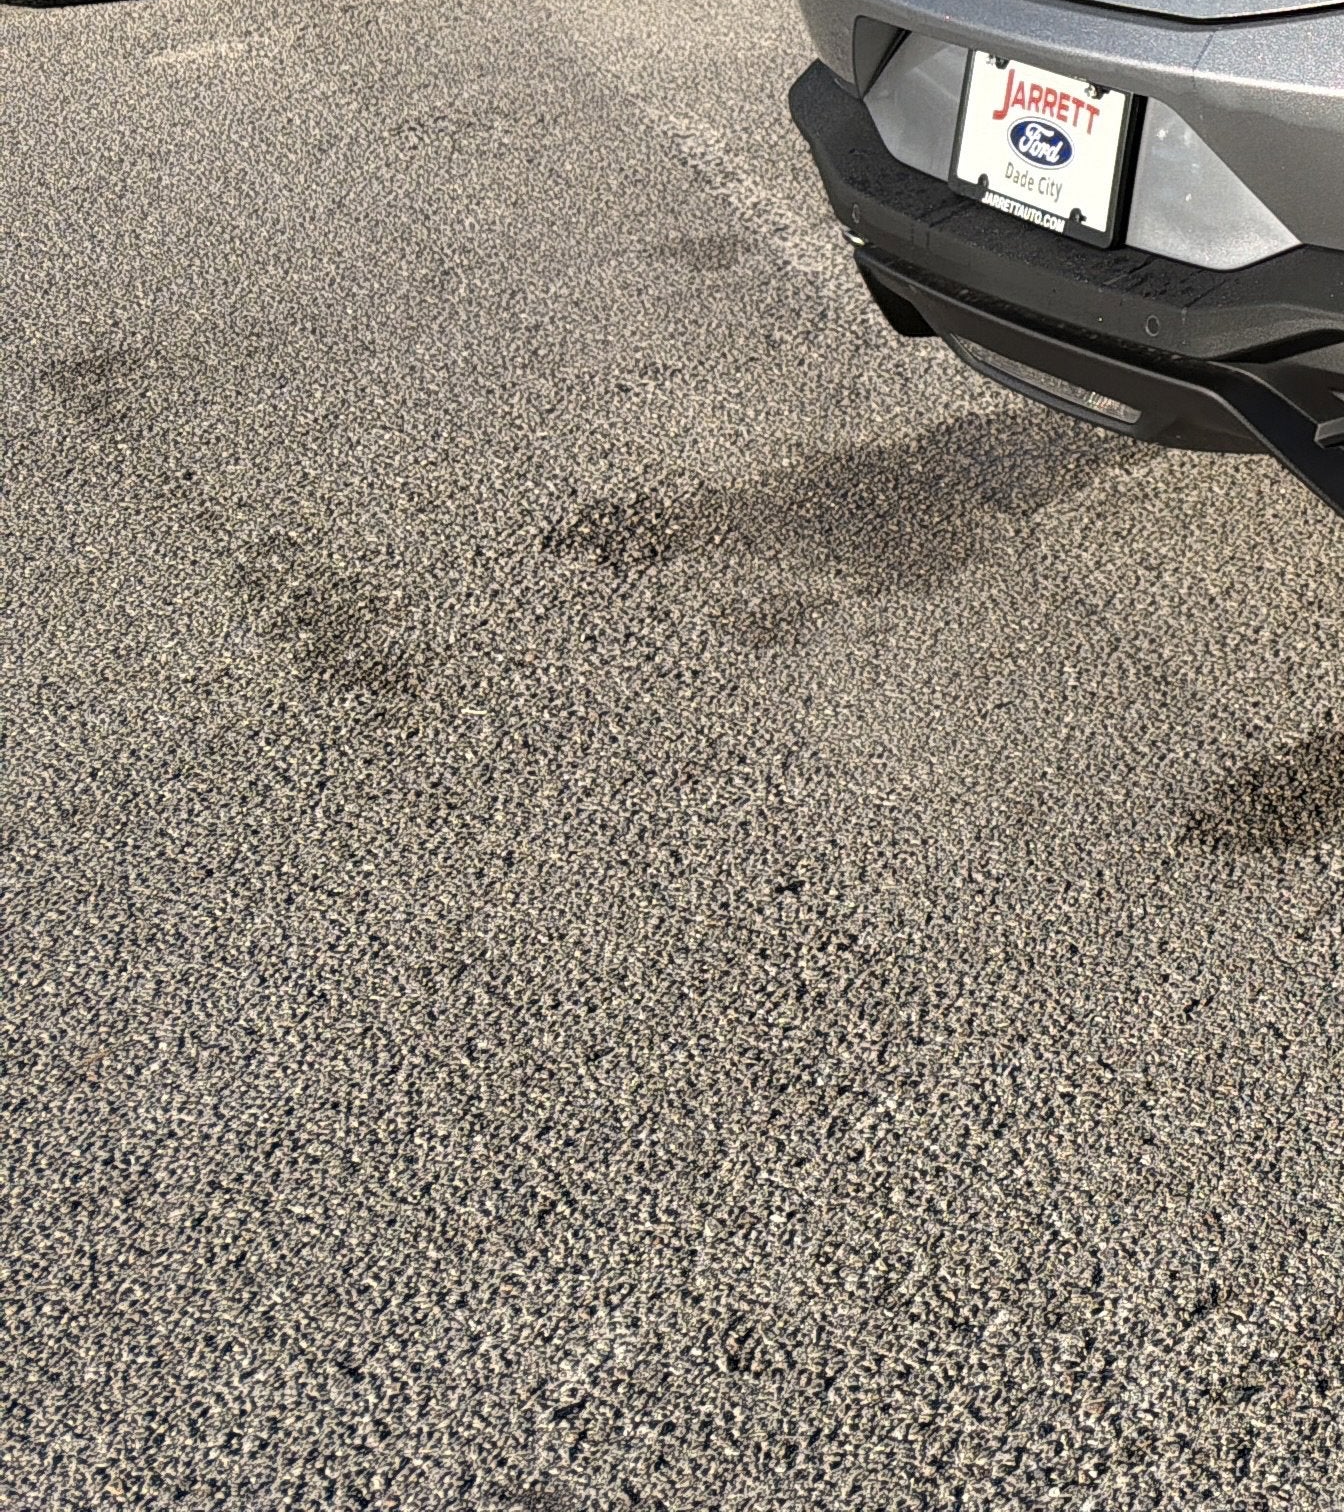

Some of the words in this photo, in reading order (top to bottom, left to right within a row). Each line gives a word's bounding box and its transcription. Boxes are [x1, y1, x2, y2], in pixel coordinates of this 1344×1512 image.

[992, 68, 1100, 136] JARRETT
[1018, 122, 1064, 163] Ford
[1005, 161, 1034, 192] Dade
[1037, 176, 1063, 203] City
[981, 190, 1067, 234] JARRETTAUTO.COM
